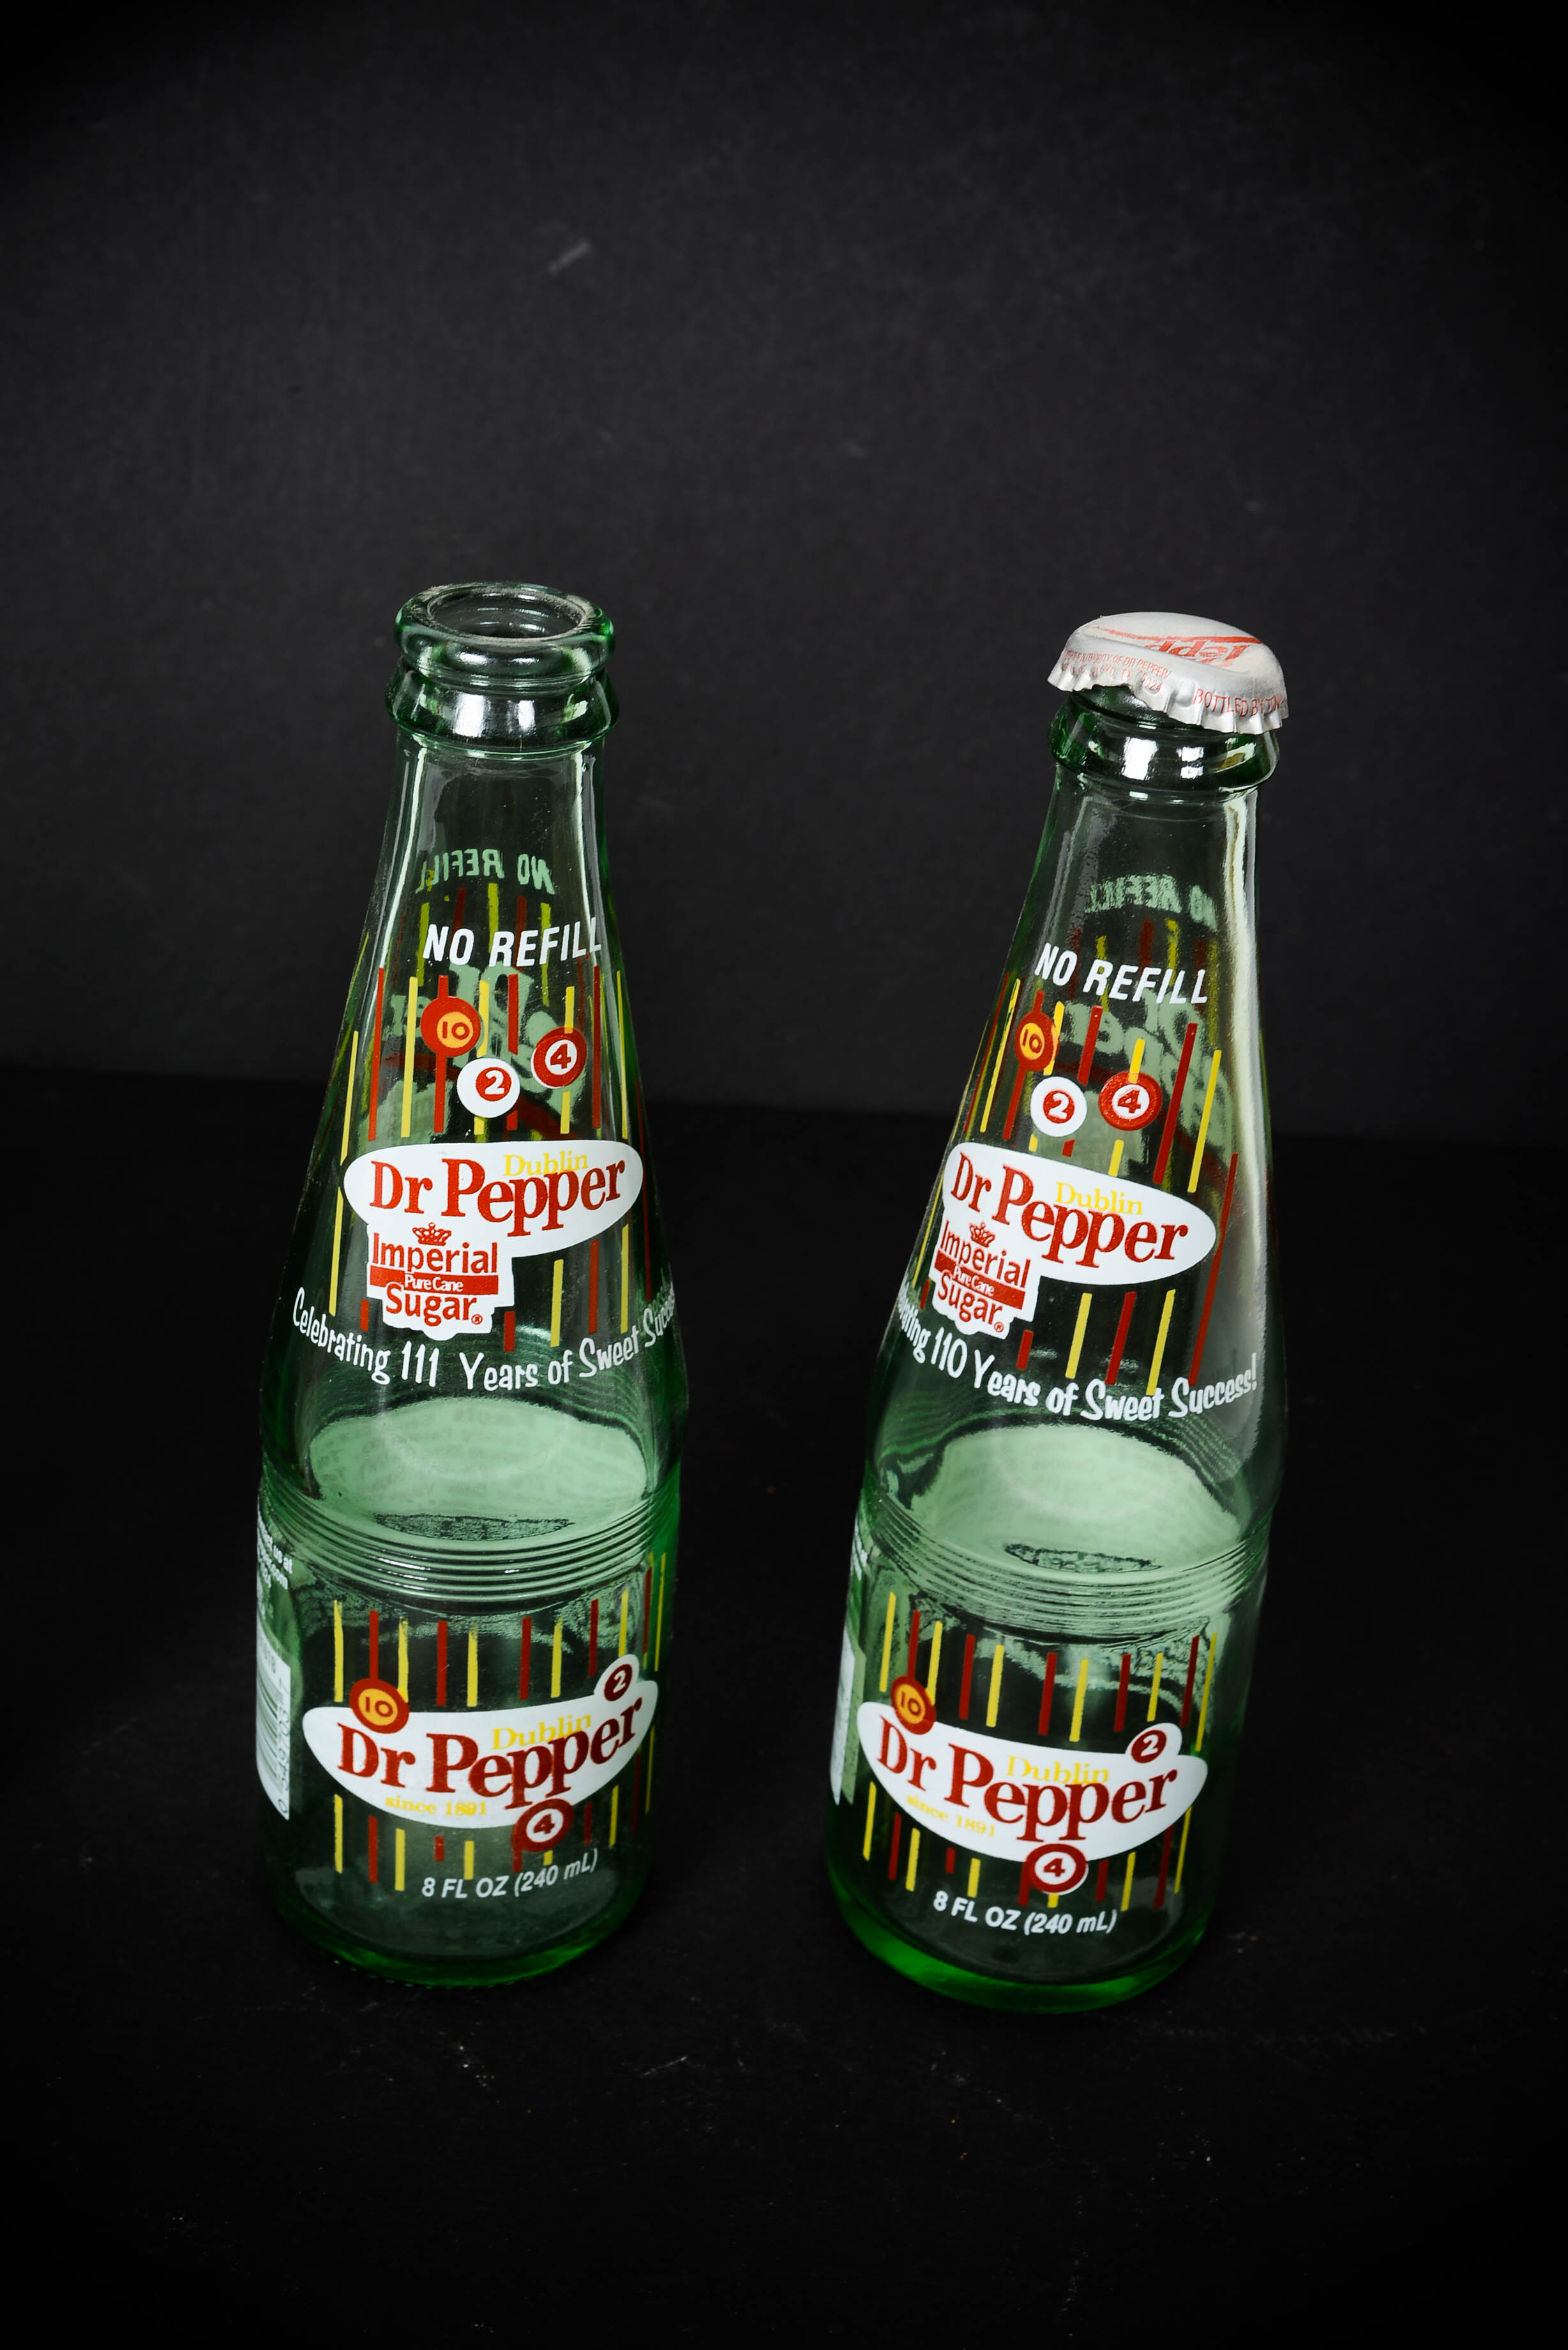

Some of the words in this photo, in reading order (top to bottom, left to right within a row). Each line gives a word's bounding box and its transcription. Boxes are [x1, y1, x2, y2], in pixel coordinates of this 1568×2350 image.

[1113, 655, 1122, 664] OF
[1124, 656, 1136, 666] DR
[1193, 688, 1249, 717] BOTTLED
[1251, 699, 1263, 716] BY
[423, 923, 475, 965] NO
[488, 916, 601, 967] REFILL
[1034, 942, 1078, 987] NO
[1082, 959, 1209, 1004] REFILL
[441, 1021, 471, 1039] 10
[1022, 1028, 1044, 1054] 10
[549, 1043, 572, 1070] 4
[484, 1069, 505, 1095] 2
[1049, 1093, 1069, 1119] 2
[1117, 1089, 1142, 1114] 4
[502, 1149, 589, 1177] Dublin
[369, 1160, 433, 1215] Dr
[441, 1157, 626, 1238] Pepper
[950, 1151, 992, 1213] Dr
[991, 1164, 1189, 1269] Pepper
[1054, 1181, 1143, 1216] Dublin
[372, 1231, 498, 1275] Imperial
[940, 1219, 1031, 1289] Imperial
[404, 1273, 432, 1291] Pure
[432, 1277, 464, 1292] Cane
[953, 1264, 972, 1287] Pure
[970, 1275, 995, 1297] Cane
[292, 1287, 391, 1385] Celebrating
[400, 1340, 440, 1388] 111
[458, 1351, 539, 1392] Years
[548, 1349, 573, 1384] of
[578, 1324, 639, 1378] Sweet
[930, 1327, 968, 1378] 110
[973, 1349, 1039, 1406] Years
[1045, 1381, 1080, 1417] of
[1080, 1378, 1165, 1421] Sweet
[1167, 1351, 1258, 1419] Success!
[613, 1670, 627, 1694] 2
[365, 1696, 393, 1718] 10
[900, 1691, 921, 1716] 10
[490, 1713, 592, 1750] Dublin
[1140, 1734, 1159, 1757] 2
[336, 1722, 416, 1788] Dr
[425, 1696, 643, 1810] Pepper
[877, 1715, 937, 1792] Dr
[944, 1743, 1178, 1842] Pepper
[1006, 1754, 1110, 1785] Dublin
[385, 1794, 436, 1814] since
[444, 1801, 487, 1816] 1891
[906, 1793, 949, 1823] since
[956, 1814, 996, 1838] 1891
[533, 1813, 555, 1835] 4
[421, 1877, 436, 1897] 8
[441, 1878, 468, 1899] FL
[475, 1875, 509, 1898] OZ
[514, 1864, 559, 1897] (240
[563, 1847, 598, 1880] mL)
[1043, 1857, 1066, 1877] 4
[933, 1890, 949, 1912] 8
[951, 1895, 979, 1923] FL
[984, 1906, 1021, 1930] OZ
[1023, 1911, 1073, 1936] (240
[1076, 1909, 1117, 1934] mL)
